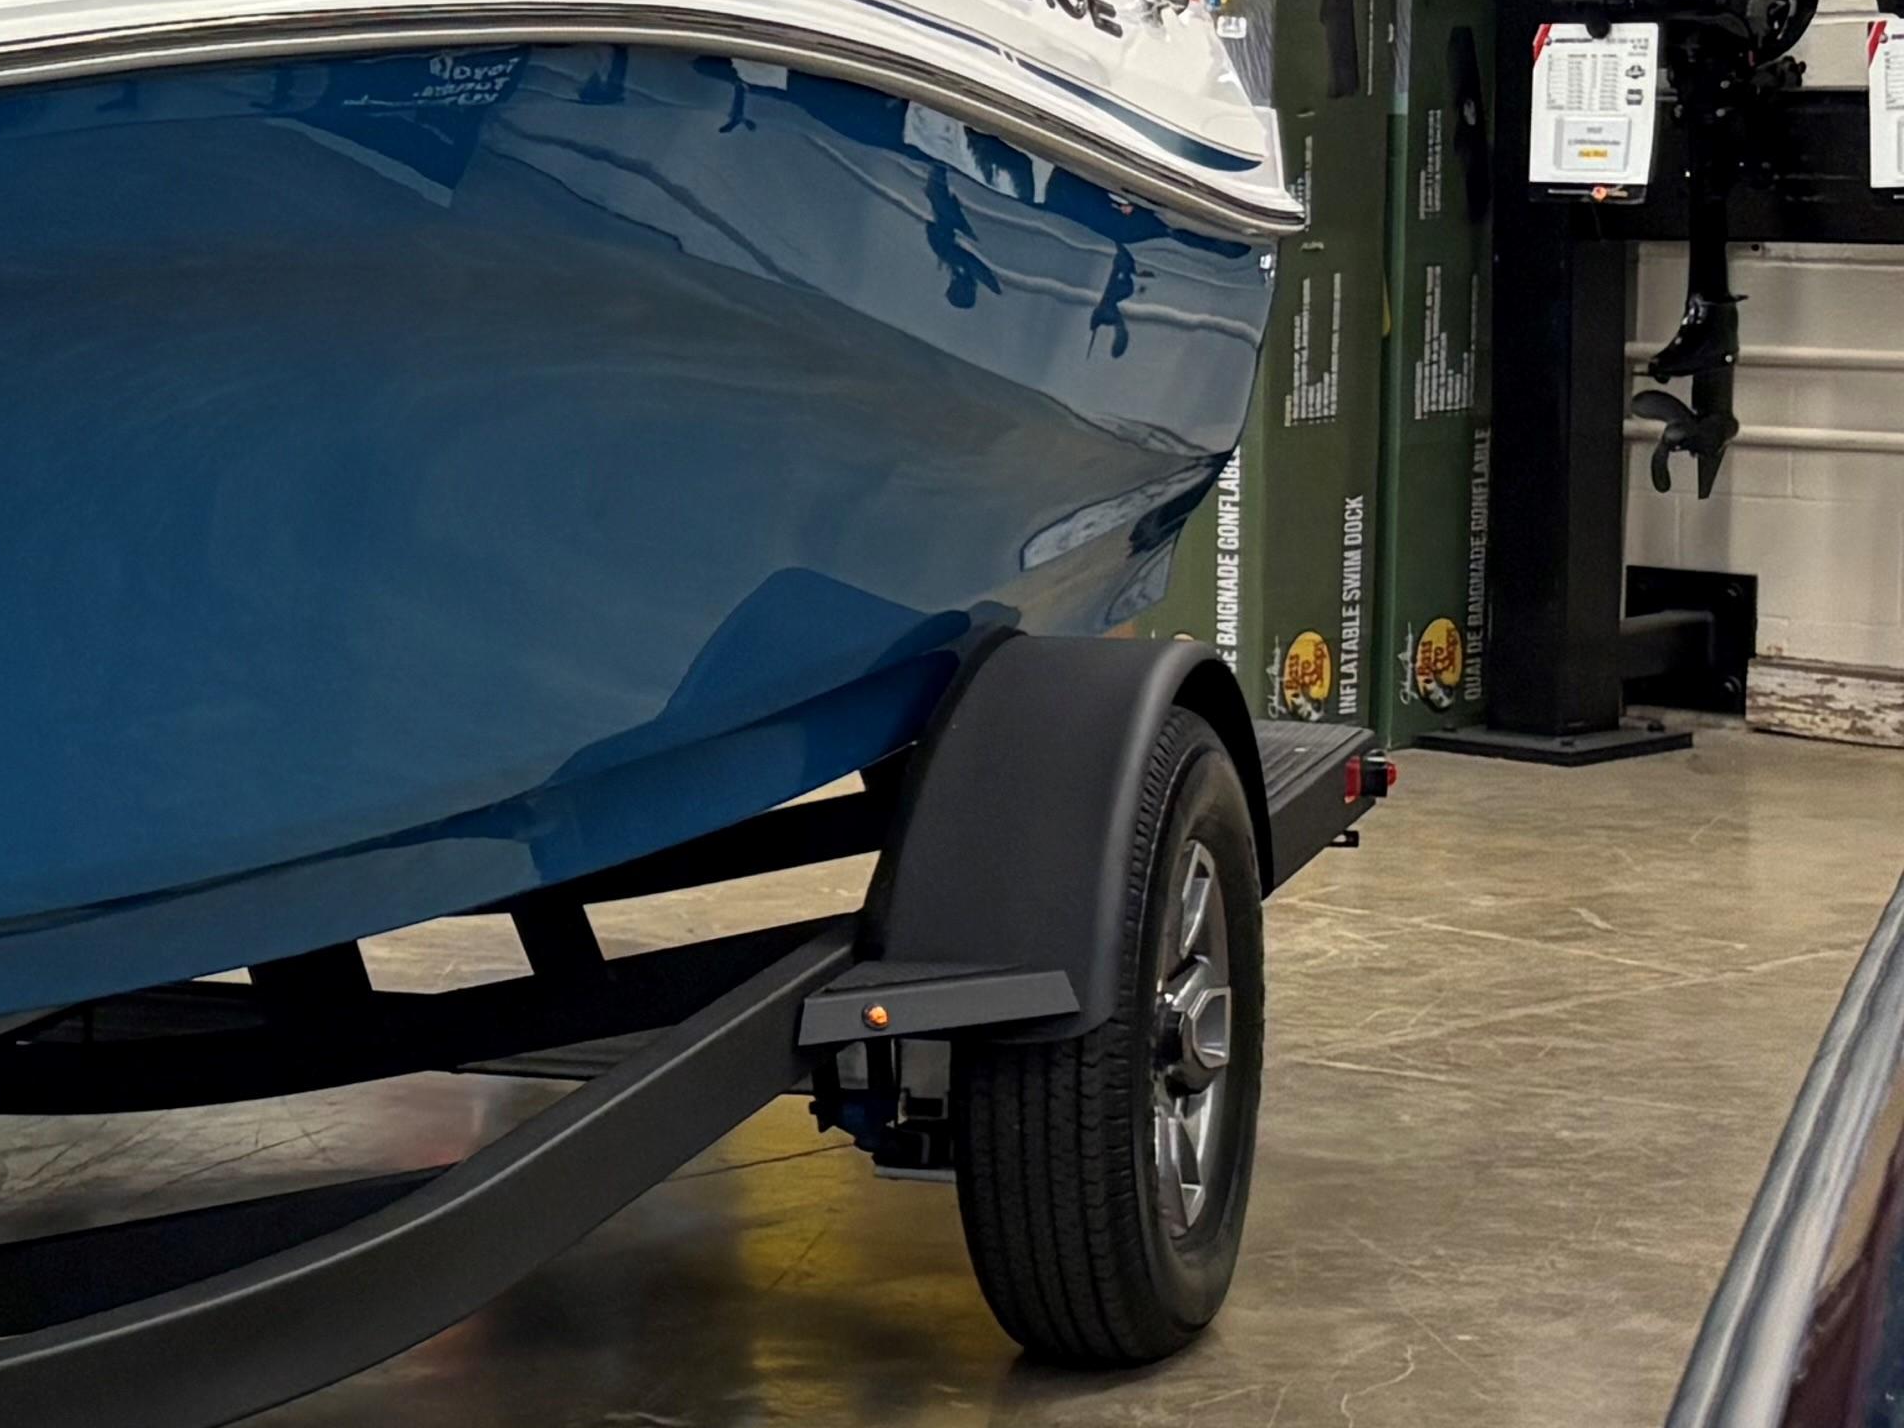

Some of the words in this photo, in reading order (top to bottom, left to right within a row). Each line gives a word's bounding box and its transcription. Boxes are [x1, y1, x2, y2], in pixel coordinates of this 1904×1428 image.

[1471, 428, 1492, 532] GONFLABLE
[1343, 494, 1364, 546] DOCK
[1341, 549, 1363, 602] SWIM
[1467, 535, 1488, 627] BAIGNADE
[1216, 554, 1239, 646] BAIGNADE
[1309, 641, 1327, 687] Shops
[1339, 604, 1361, 715] INFLATABLE
[1417, 640, 1433, 677] Bass
[1432, 647, 1446, 677] Pro
[1443, 627, 1459, 675] Shops
[1466, 631, 1483, 654] DE
[1284, 653, 1300, 691] Bass
[1299, 659, 1313, 690] Pro
[1464, 658, 1482, 701] QUAI
